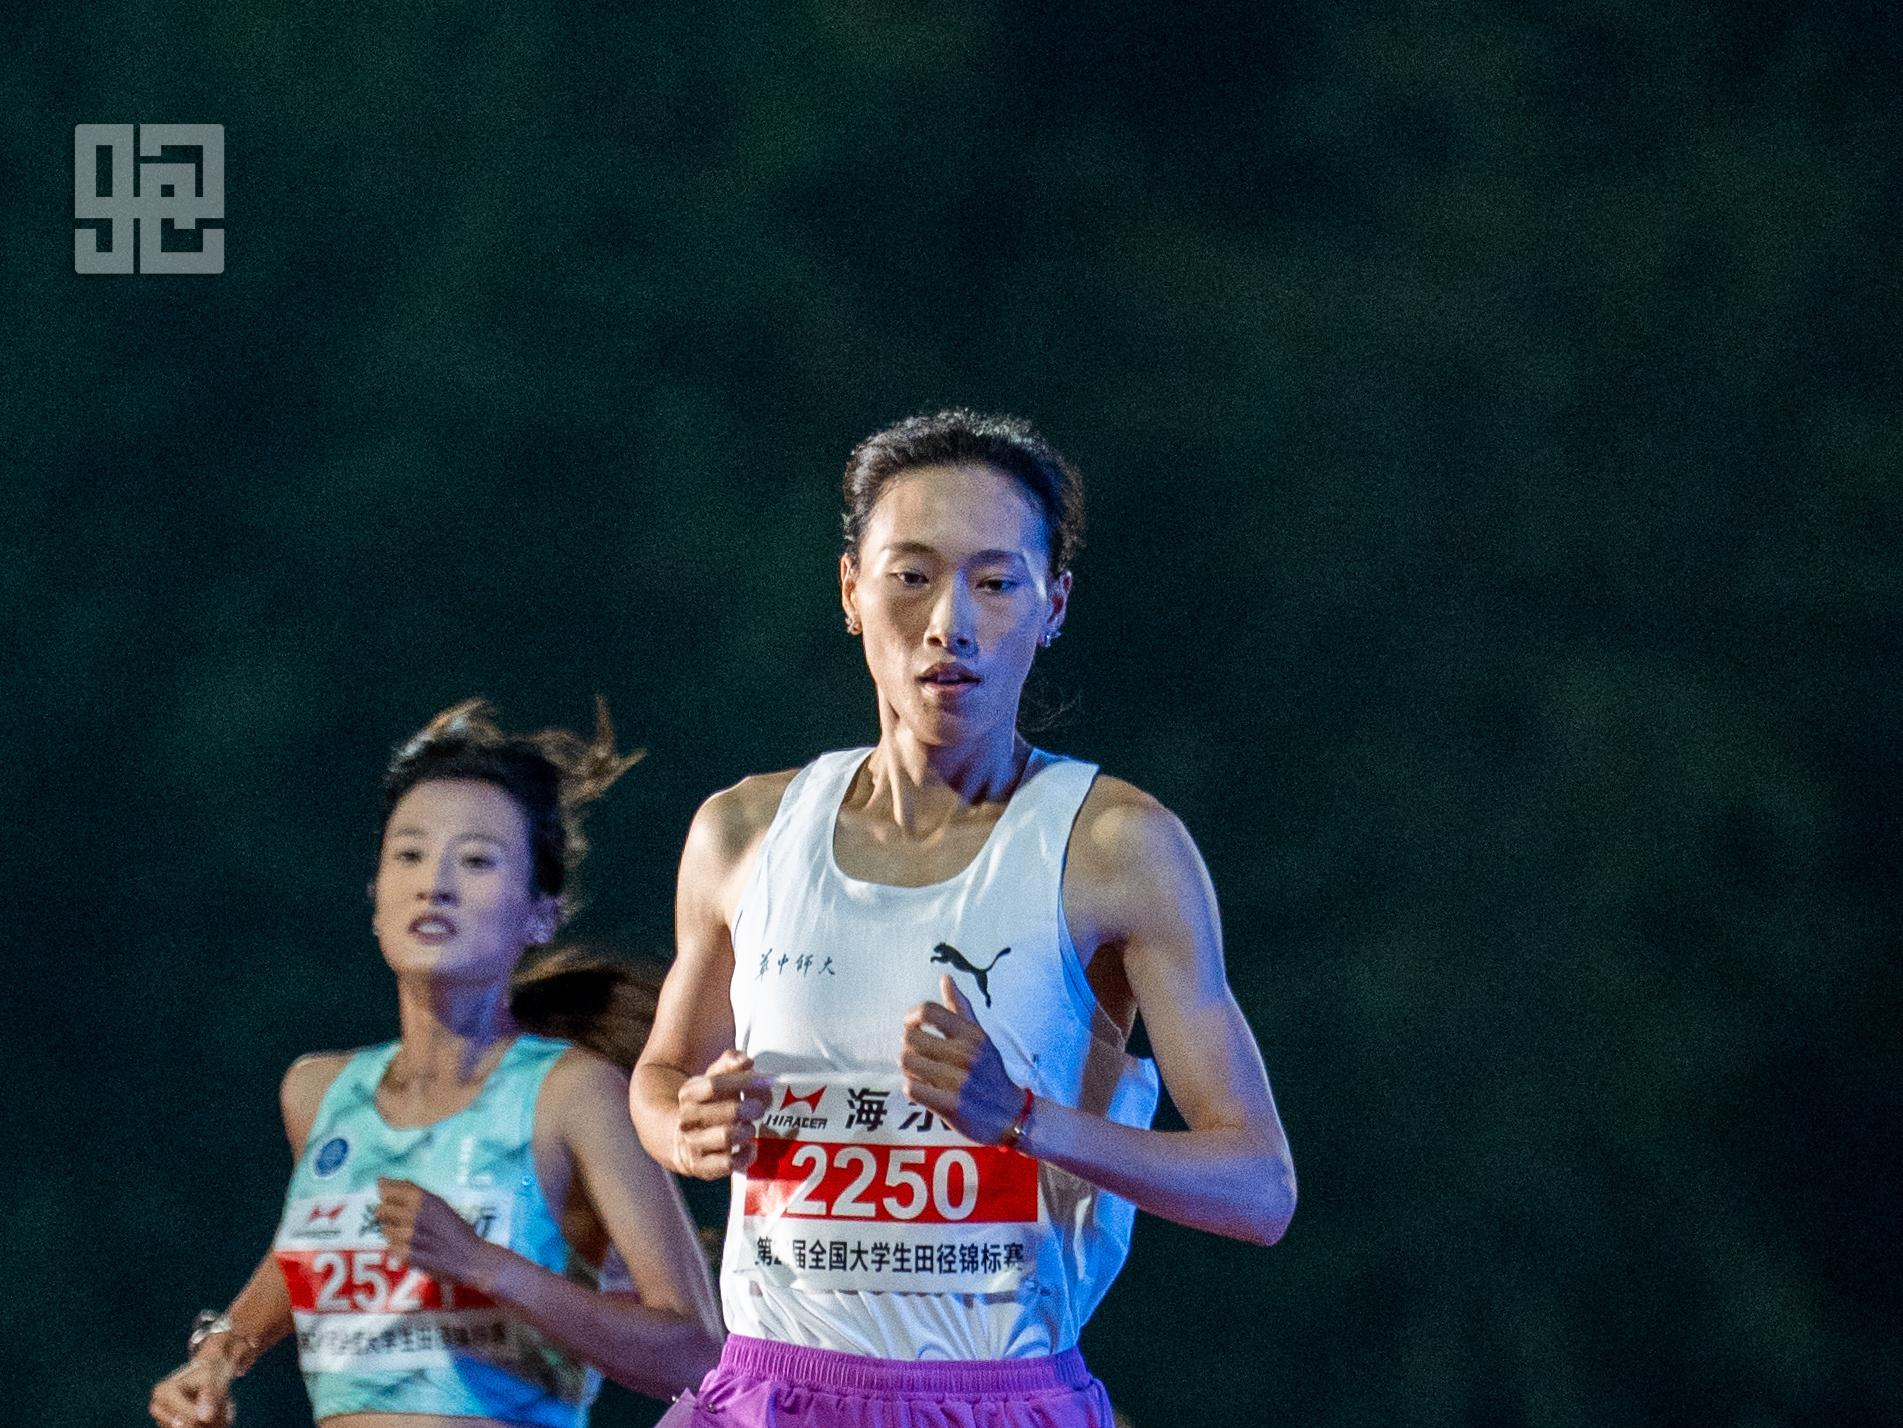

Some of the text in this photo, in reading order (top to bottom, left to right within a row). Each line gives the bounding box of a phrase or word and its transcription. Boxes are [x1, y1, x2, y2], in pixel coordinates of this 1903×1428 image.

[766, 1114, 828, 1130] HIRACER
[786, 1144, 979, 1220] 2250
[754, 1236, 1024, 1273] 第届全国大学生田径锦标赛
